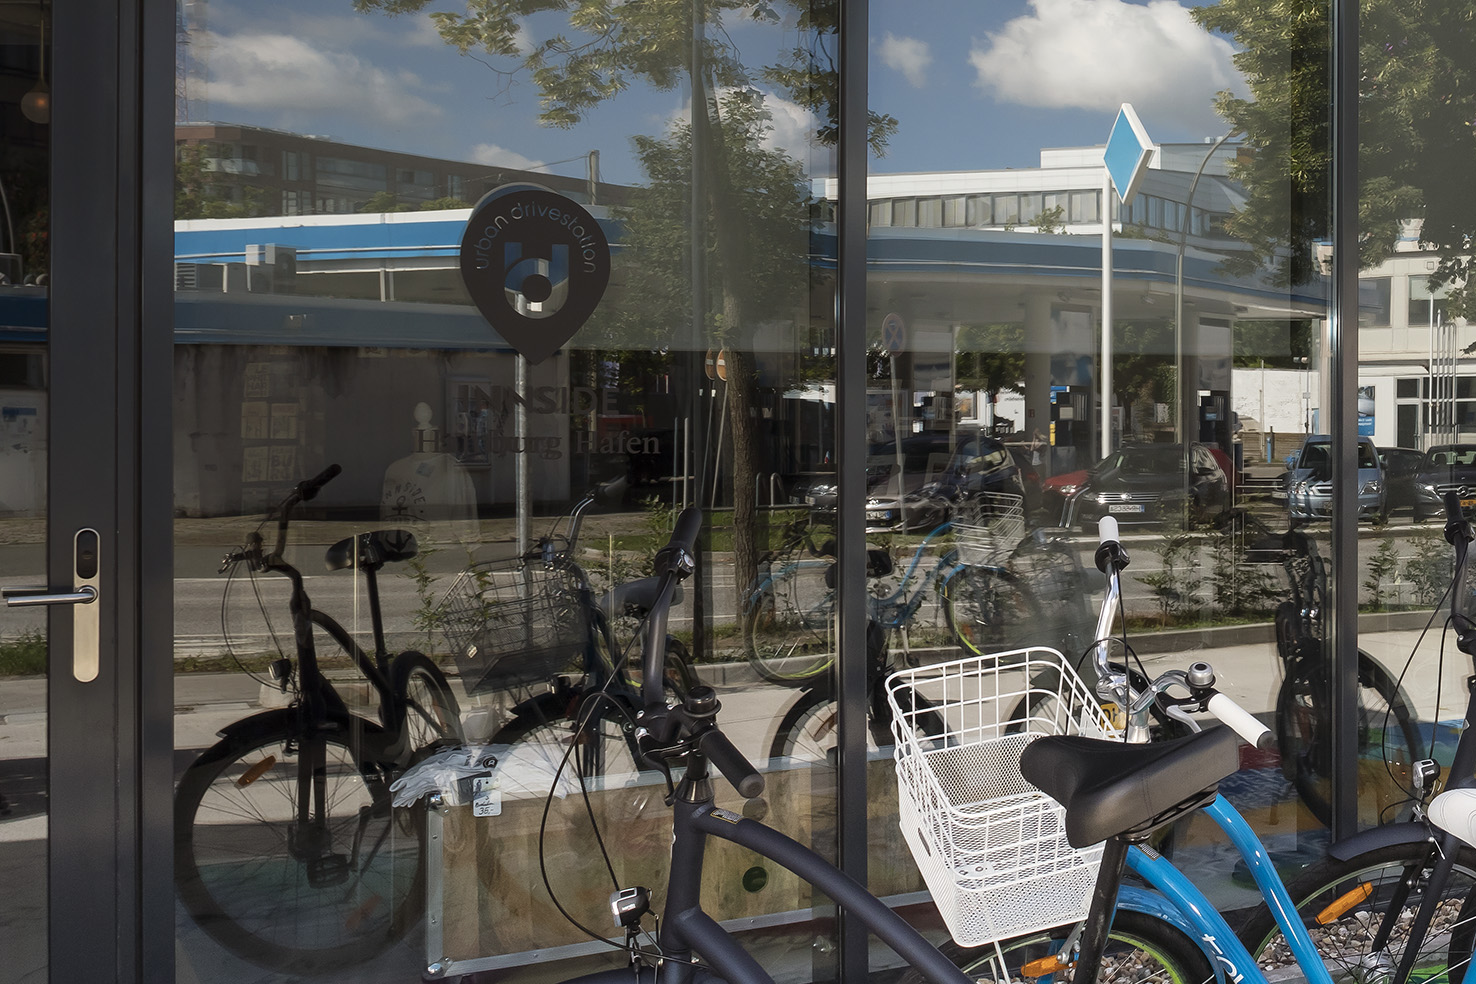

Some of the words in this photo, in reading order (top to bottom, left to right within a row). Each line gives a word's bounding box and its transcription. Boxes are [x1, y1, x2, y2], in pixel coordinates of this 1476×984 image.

[473, 215, 509, 269] urban
[511, 201, 597, 273] drivestation
[457, 385, 620, 415] INNSIDE
[576, 430, 662, 454] Hafen
